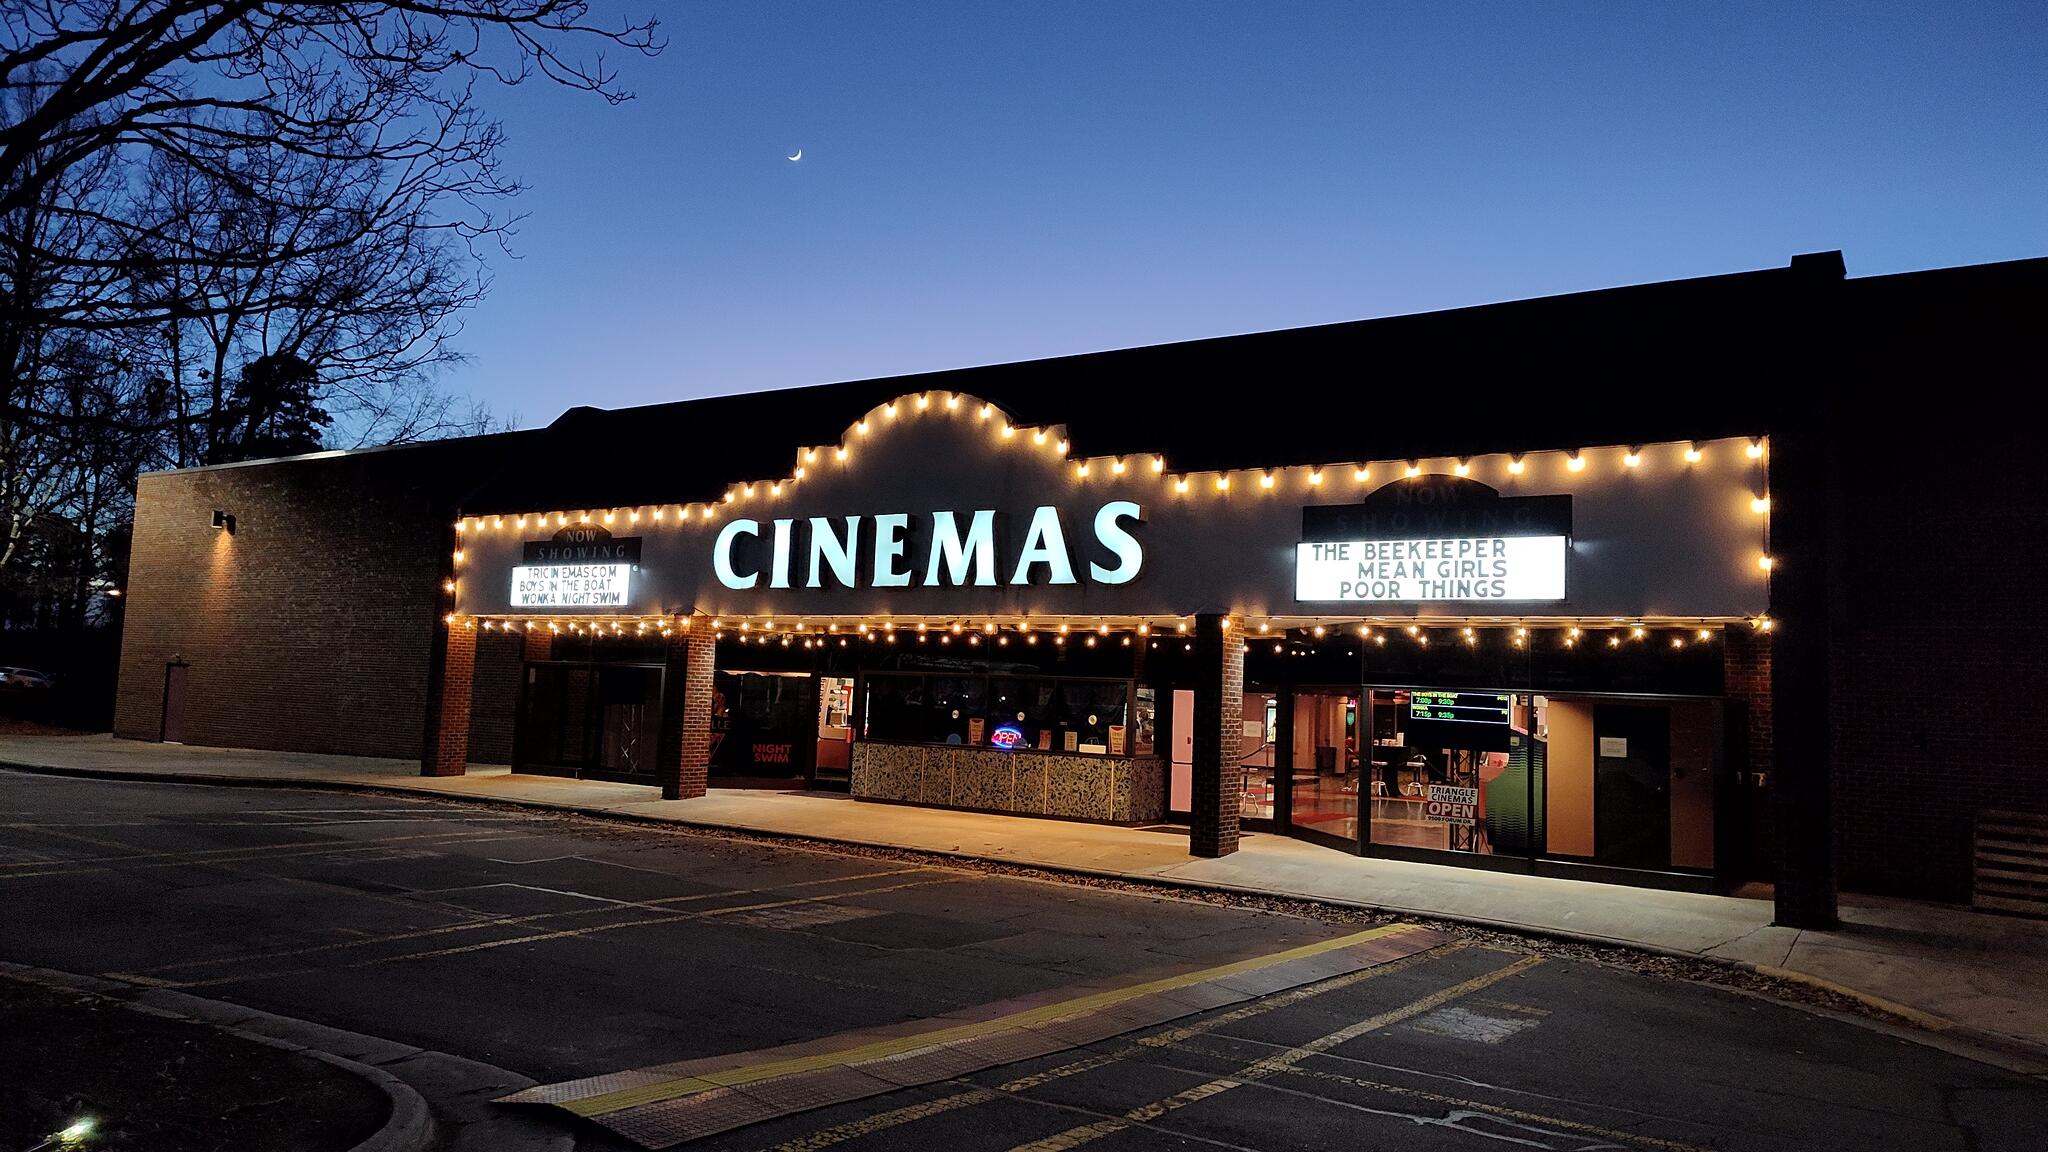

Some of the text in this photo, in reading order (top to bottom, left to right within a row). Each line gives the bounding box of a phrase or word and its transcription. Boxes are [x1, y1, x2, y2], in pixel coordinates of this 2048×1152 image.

[566, 529, 597, 543] NOW
[537, 544, 625, 560] SHOWING
[712, 500, 1144, 591] CINEMAS
[1312, 539, 1506, 561] THE BEEKEEPER
[1358, 559, 1507, 580] MEAN GIRLS
[519, 578, 612, 592] BOYS IN THE BOAT
[1340, 579, 1506, 599] POOR THINGS
[521, 591, 621, 605] WONKA NIGHT SWIM
[752, 743, 793, 754] NIGHT
[753, 753, 789, 764] SWIM
[1431, 786, 1476, 797] TRIANGLE
[1431, 793, 1473, 804] CINEMAS
[1428, 802, 1474, 818] OPEN
